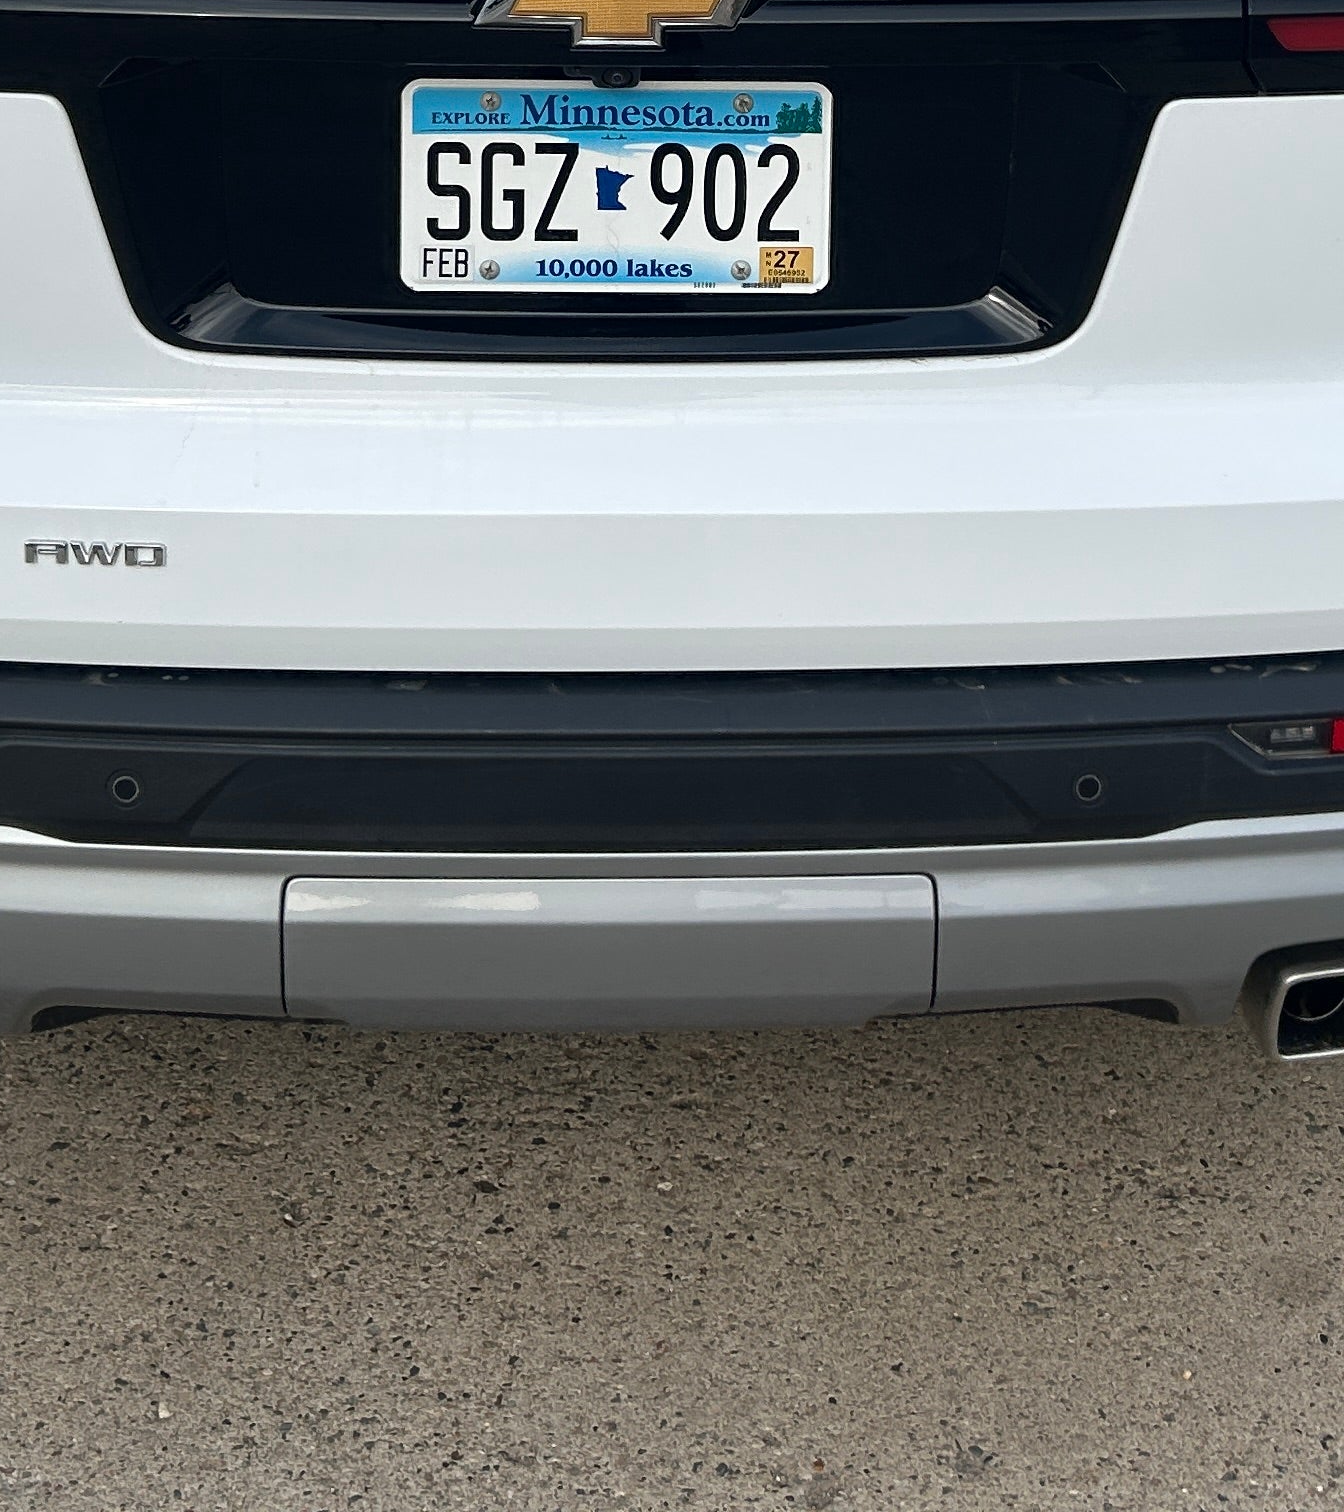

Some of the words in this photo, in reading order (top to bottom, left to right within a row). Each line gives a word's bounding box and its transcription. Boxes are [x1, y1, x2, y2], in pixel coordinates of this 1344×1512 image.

[431, 111, 511, 126] EXPLORE
[520, 93, 771, 128] Minnesota.com
[426, 141, 580, 242] SGZ
[650, 142, 801, 242] 902
[422, 248, 469, 278] FEB
[535, 258, 618, 279] 10,000
[627, 258, 693, 278] lakes
[773, 250, 800, 268] 27
[23, 539, 168, 568] AWD
